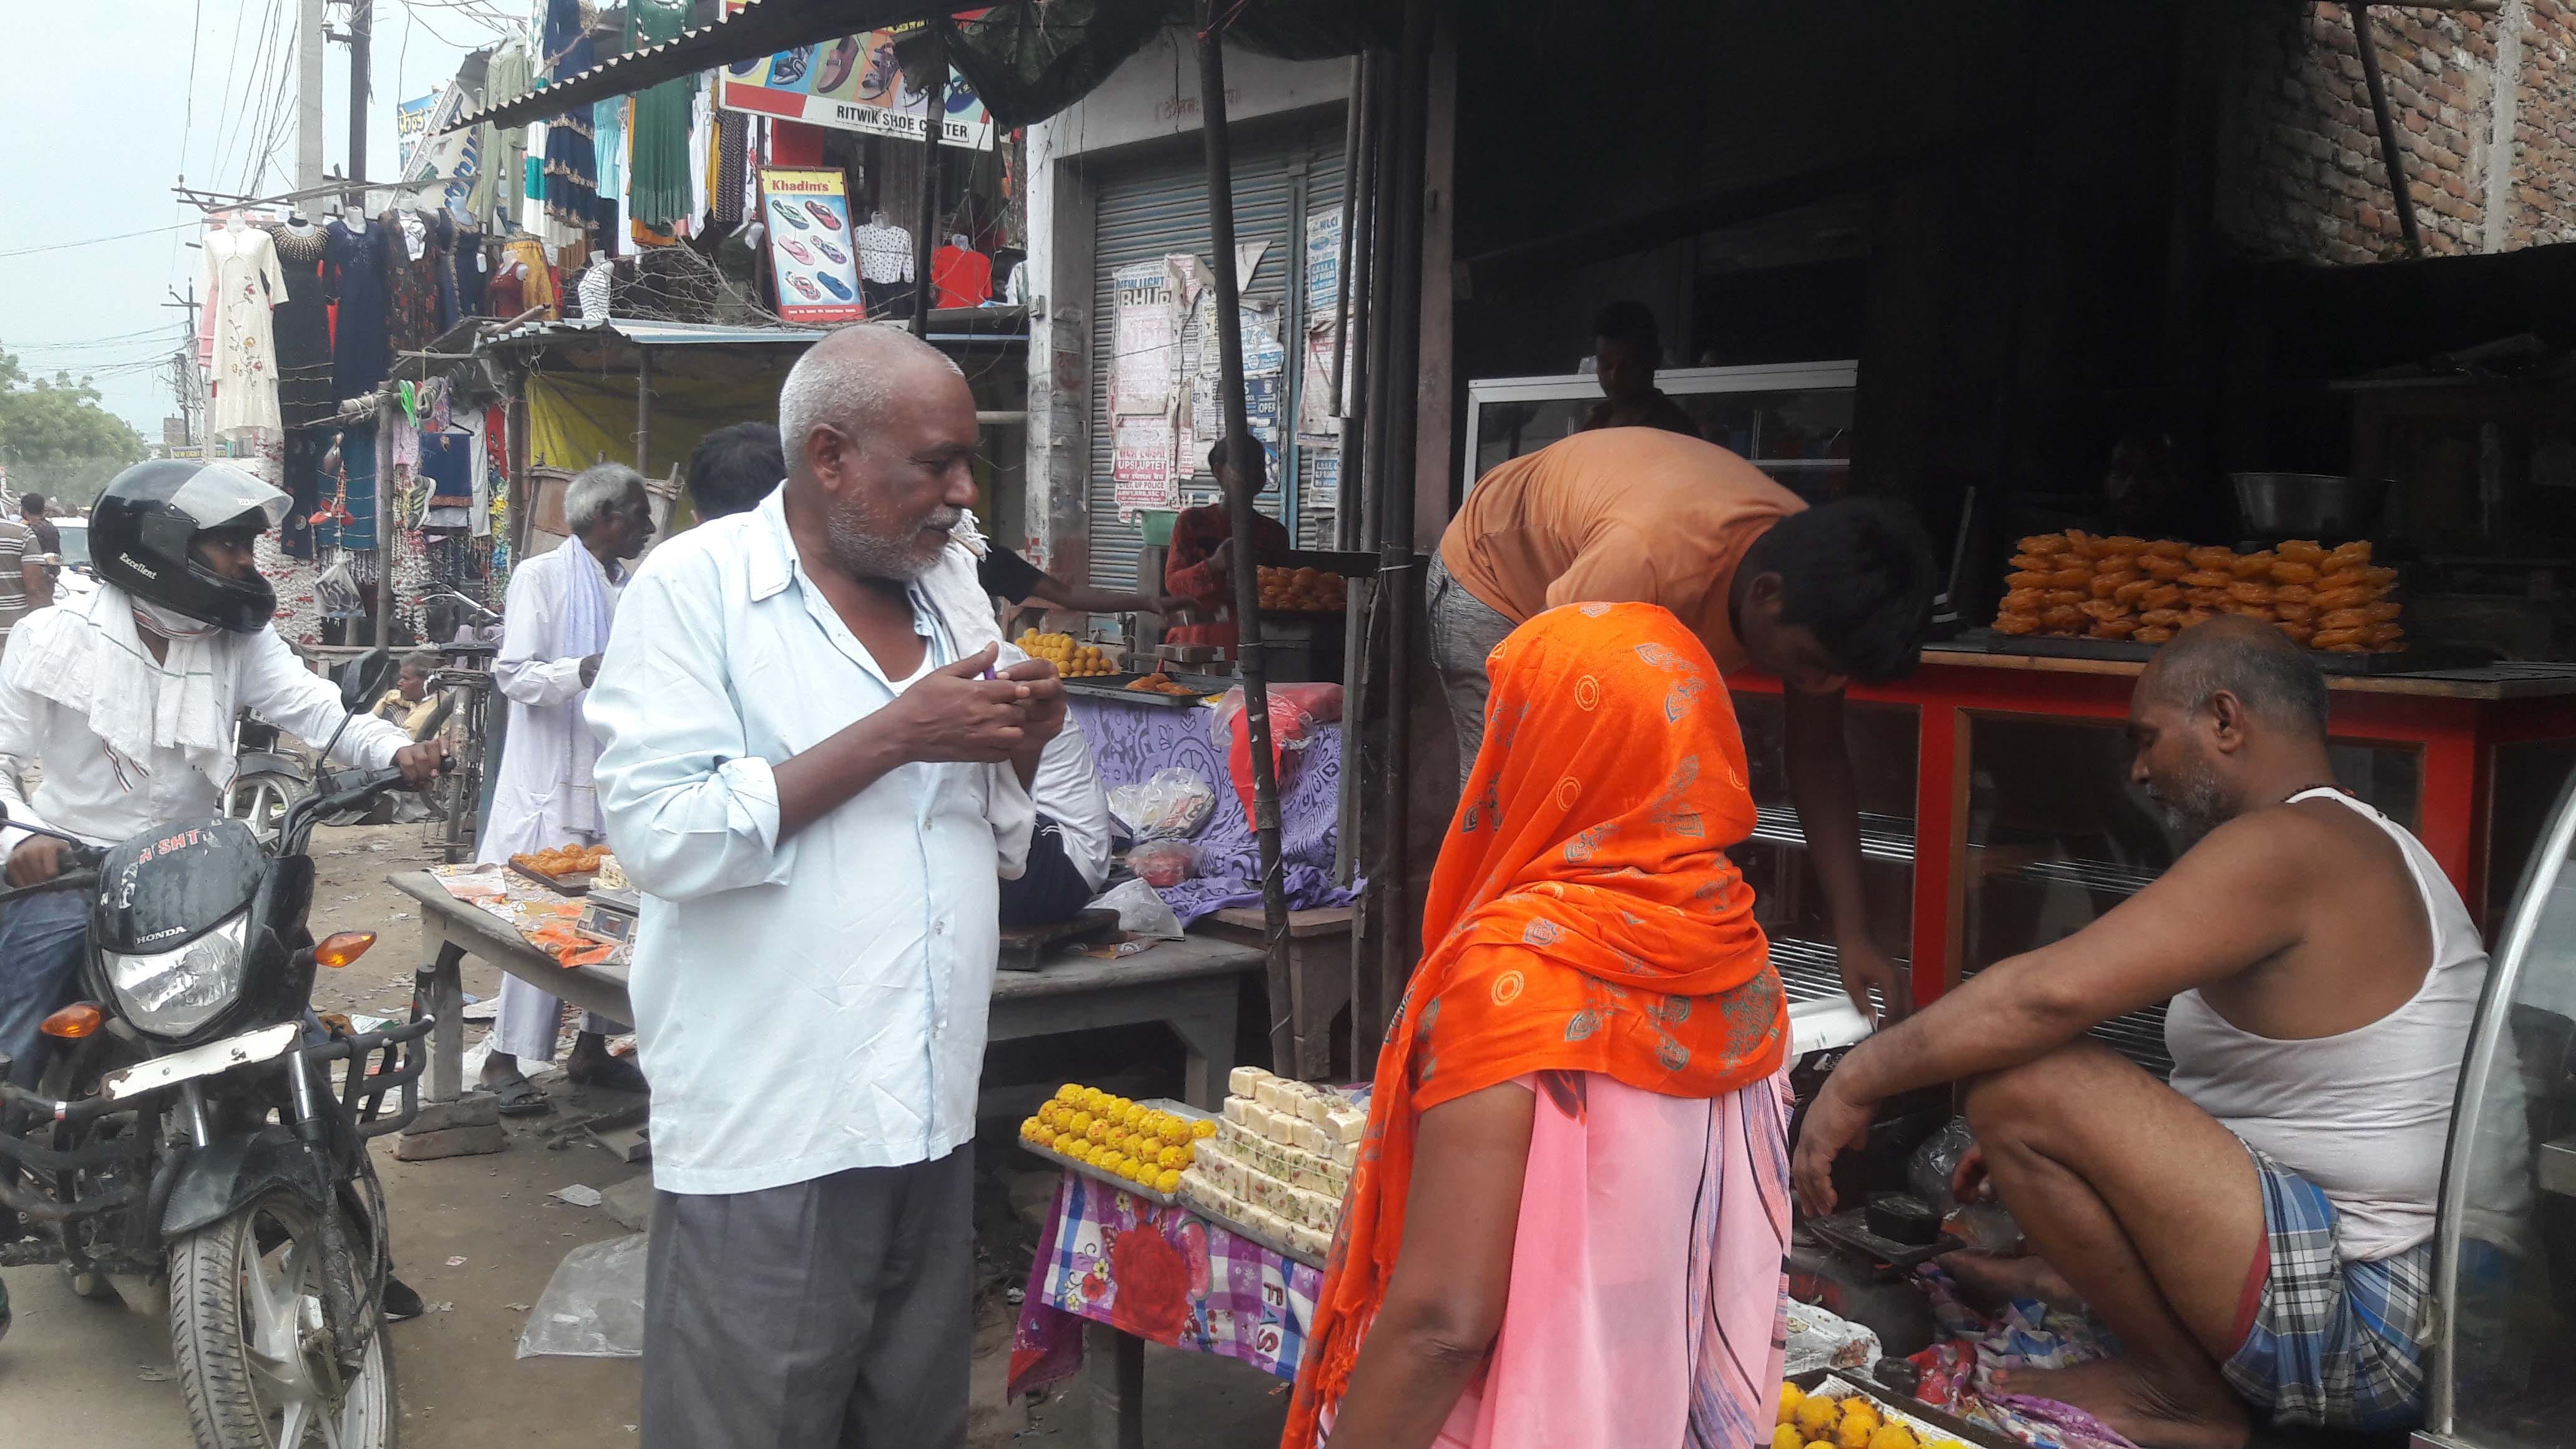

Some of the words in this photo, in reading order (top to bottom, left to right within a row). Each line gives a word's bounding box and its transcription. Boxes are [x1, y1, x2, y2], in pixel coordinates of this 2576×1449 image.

[837, 105, 879, 124] RITWIK
[882, 113, 914, 130] SHOE
[919, 119, 967, 138] CTER
[772, 180, 829, 192] Khadim's
[1258, 402, 1276, 414] OPEN
[119, 552, 157, 580] Excellent
[135, 926, 187, 944] HONDA
